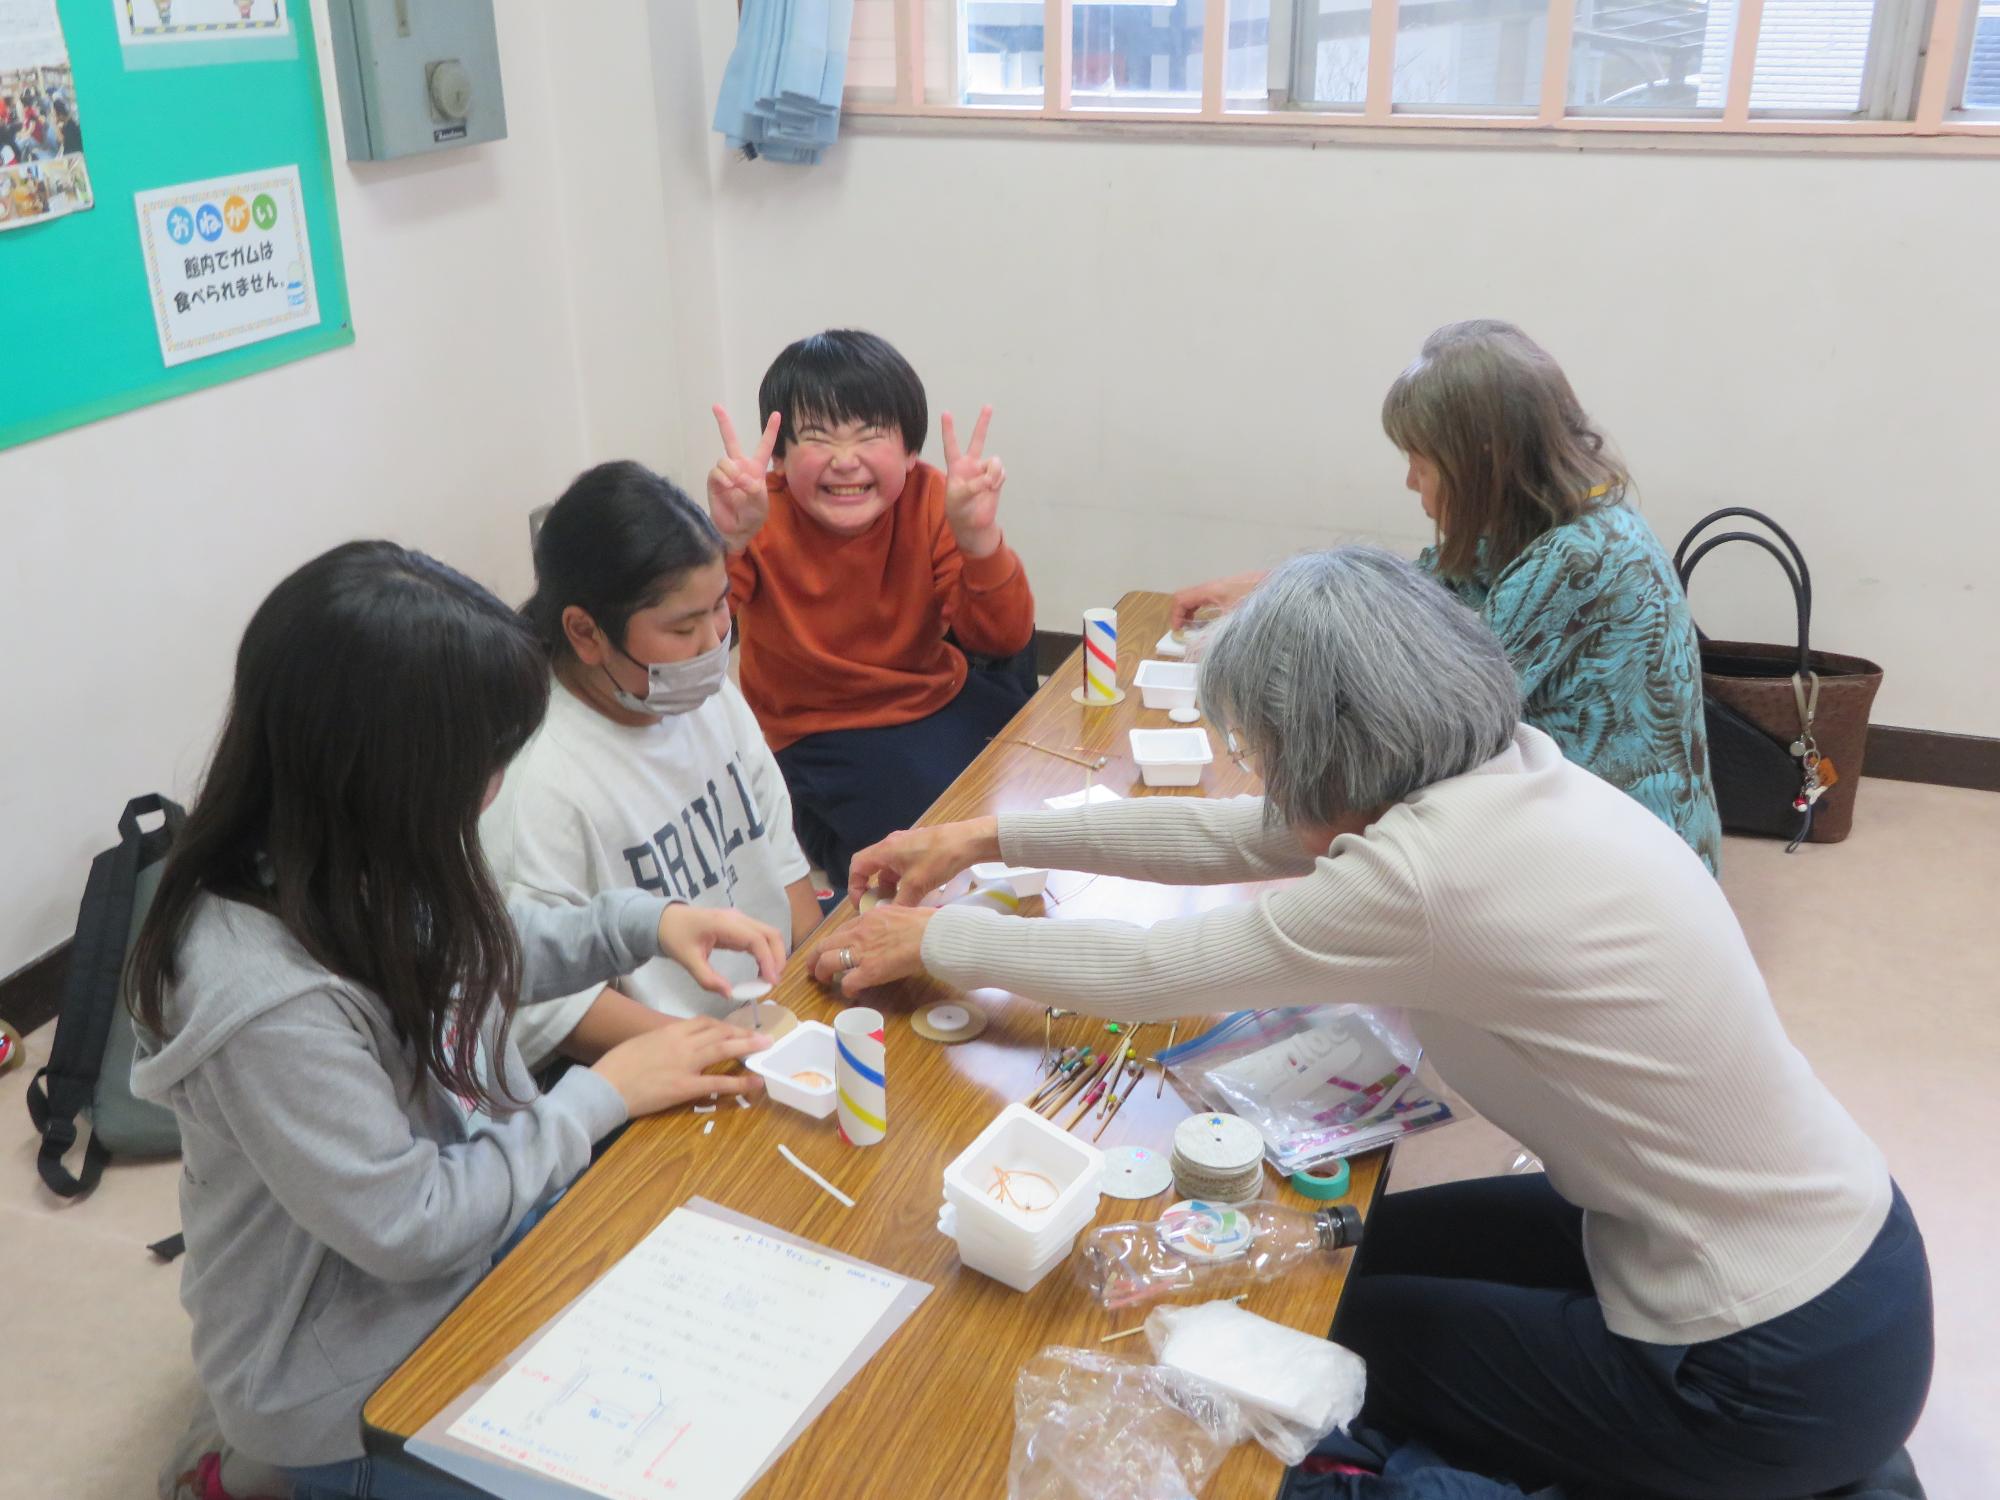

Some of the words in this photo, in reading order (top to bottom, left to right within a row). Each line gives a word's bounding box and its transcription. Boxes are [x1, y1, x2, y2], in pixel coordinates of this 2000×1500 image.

[168, 200, 276, 243] おねがい
[184, 240, 274, 279] 館内でガムは
